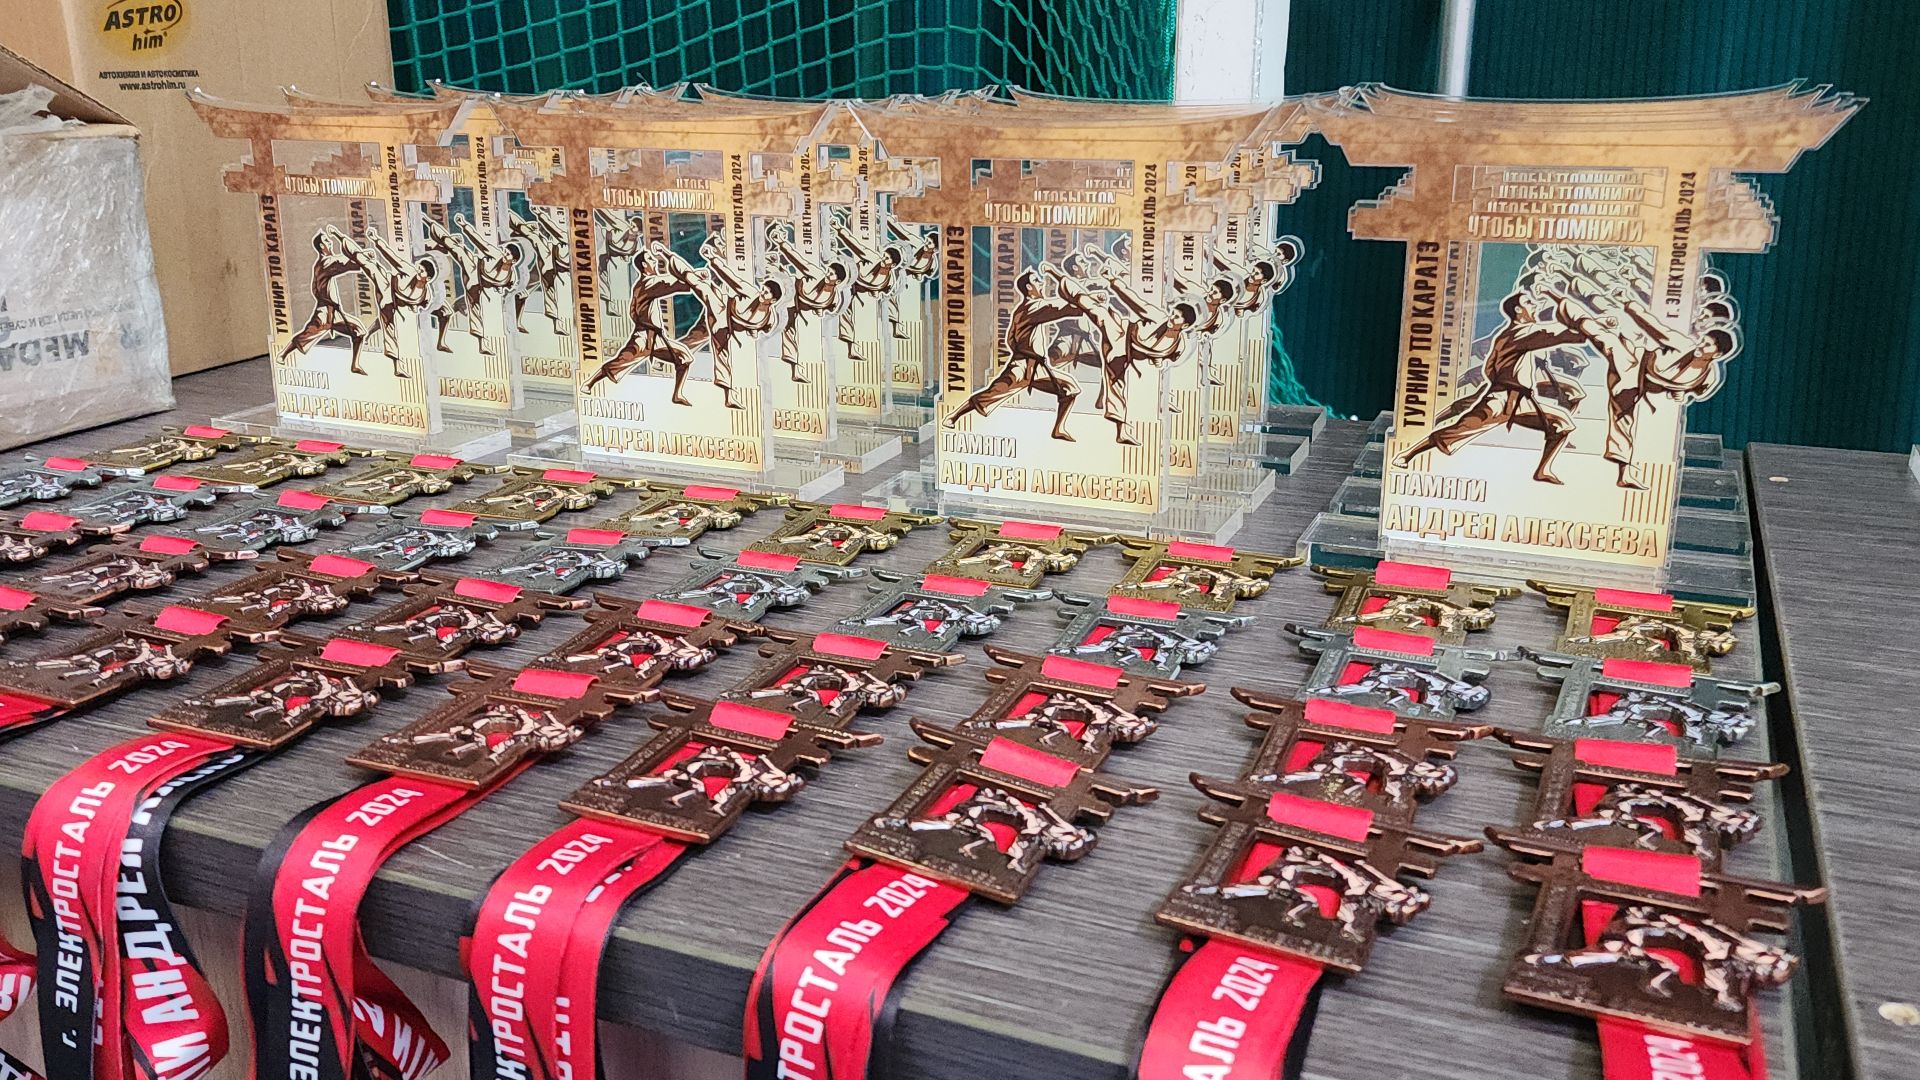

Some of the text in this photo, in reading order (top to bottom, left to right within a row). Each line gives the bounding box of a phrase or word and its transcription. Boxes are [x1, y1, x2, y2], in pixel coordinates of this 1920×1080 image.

[104, 4, 177, 31] ASTRO
[132, 33, 163, 51] him
[119, 80, 186, 91] www.astrohim.ru
[147, 70, 200, 78] АВТОКОСМЕТИКА
[386, 146, 397, 170] 2024
[475, 136, 486, 160] 2024
[731, 153, 742, 181] 2024
[1144, 163, 1157, 193] 2024
[284, 176, 376, 197] ЧТОБЫ ПОМНИЛИ
[477, 163, 491, 228] ЭЛЕКТРОСТАЛЬ
[603, 188, 715, 211] ЧТОБЫ ПОМНИЛИ
[1678, 171, 1697, 205] 2024
[388, 171, 404, 243] ЭЛЕКТРОСТАЛЬ
[731, 183, 746, 262] ЭЛЕКТРОСТАЛЬ
[984, 202, 1121, 227] ЧТОБЫ ПОМНИЛИ
[1141, 196, 1156, 283] ЭЛЕКТРОСТАЛЬ
[1468, 215, 1643, 242] ЧТОБЫ ПОМНИЛИ
[261, 194, 288, 334] ТУРНИР ПО КАРАТЭ
[1665, 208, 1692, 305] ЭЛЕКТРОСТАЛЬ
[572, 208, 598, 361] ТУРНИР ПО КАРАТЭ
[946, 225, 966, 393] ТУРНИР ПО КАРАТЭ
[1403, 239, 1440, 427] ТУРНИР ПО КАРАТЭ
[277, 368, 330, 389] ПАМЯТИ
[279, 391, 425, 428] АНДРЕЯ АЛЕКСЕЕВА
[580, 397, 644, 421] ПАМЯТИ
[582, 424, 758, 464] АНДРЕЯ АЛЕКСЕЕВА
[941, 431, 1016, 459] ПАМЯТИ
[942, 459, 1152, 505] АНДРЕЯ АЛЕКСЕЕВА
[1388, 470, 1488, 502] ПАМЯТИ
[1385, 504, 1658, 558] АНДРЕЯ АЛЕКСЕЕВА
[107, 740, 190, 775] 2024
[345, 788, 424, 827] 2024
[53, 781, 116, 1014] ЭЛЕКТРОСТАЛЬ
[863, 873, 939, 918] 2024
[492, 885, 552, 1080] КТРОСТАЛЬ
[536, 833, 614, 875] 2024
[1211, 956, 1280, 1011] 2024
[61, 1029, 77, 1049] г.
